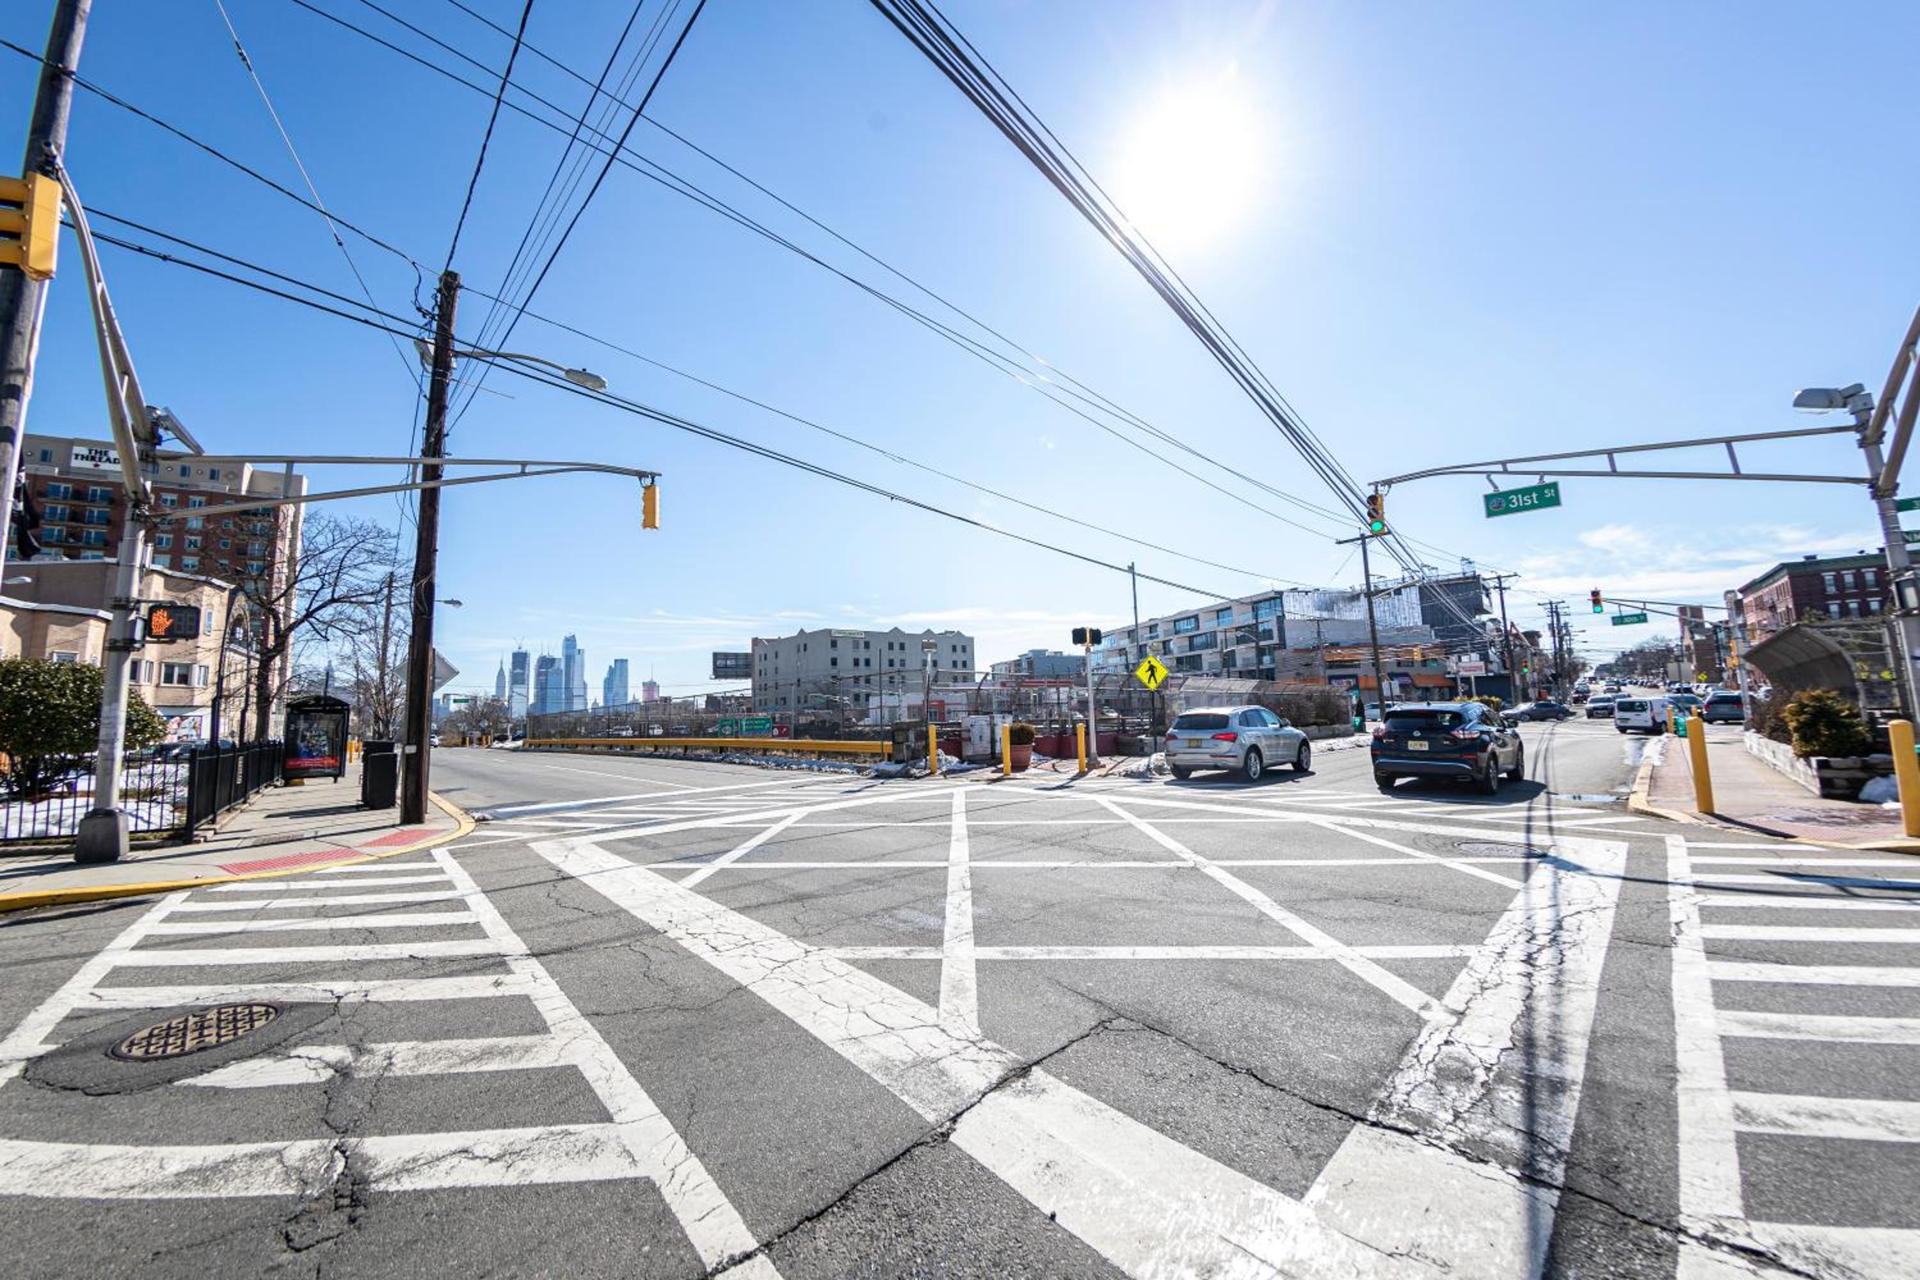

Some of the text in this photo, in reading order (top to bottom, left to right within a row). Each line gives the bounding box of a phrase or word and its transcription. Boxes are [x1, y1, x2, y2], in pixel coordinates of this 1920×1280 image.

[87, 448, 109, 456] THE
[1508, 488, 1555, 509] 31st St
